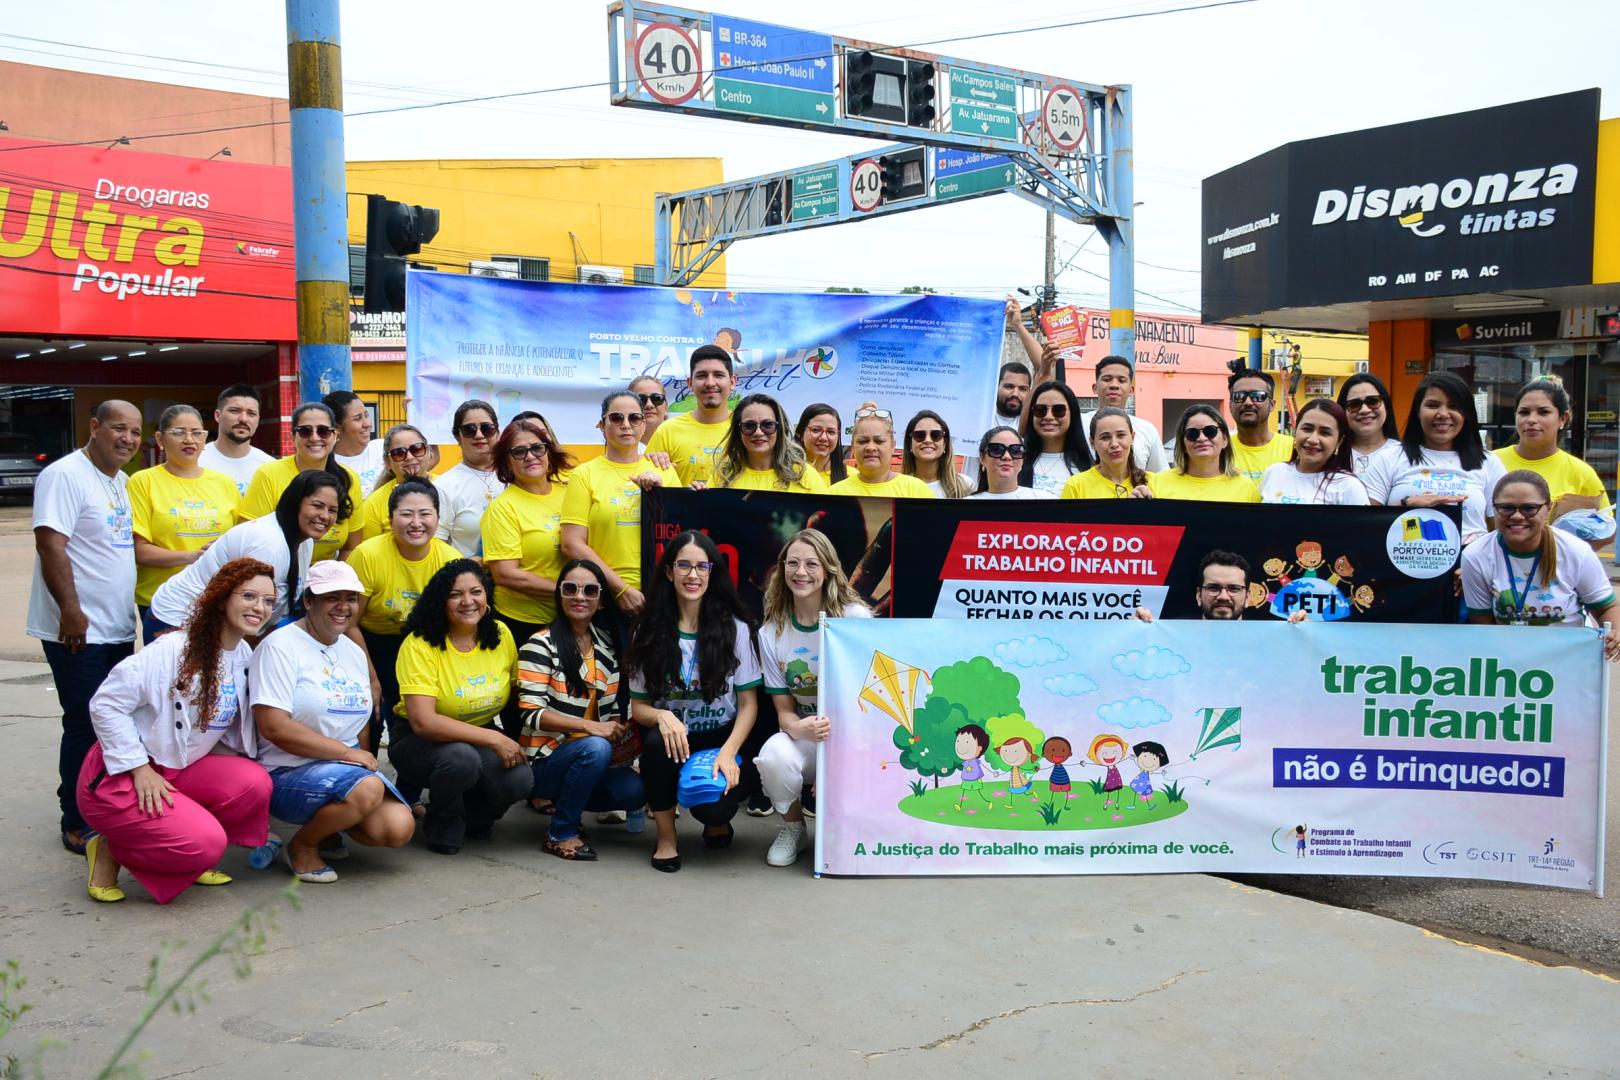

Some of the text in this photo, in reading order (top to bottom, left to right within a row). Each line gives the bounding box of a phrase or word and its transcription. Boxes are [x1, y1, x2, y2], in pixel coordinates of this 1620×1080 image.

[734, 31, 767, 49] BR-364
[643, 41, 692, 76] 40
[784, 64, 807, 80] Paulo
[808, 68, 815, 80] II
[656, 82, 685, 93] Km/h
[951, 72, 1015, 94] Av. Campos Sales
[721, 89, 752, 104] Centro
[959, 108, 1010, 126] Av. Jatuarana
[1051, 109, 1080, 127] 5,5m
[948, 153, 981, 168] Hosp. João
[806, 172, 833, 184] Jatuarana
[855, 171, 879, 194] 40
[94, 178, 210, 209] Drogarias
[938, 183, 959, 194] Centro
[1311, 162, 1579, 226] Dismonza
[801, 198, 821, 209] Campos
[822, 195, 836, 205] Sales
[0, 186, 206, 267] Ultra
[1459, 206, 1557, 236] tintas
[72, 263, 206, 300] Popular
[1368, 265, 1500, 288] RO AM DF PA AC
[590, 332, 621, 341] PORTO
[624, 334, 654, 342] VELHO
[656, 335, 695, 344] CONTRA
[1475, 321, 1532, 340] Suvinil
[488, 344, 493, 355] A
[578, 348, 583, 360] O
[1153, 344, 1181, 365] Bom
[459, 361, 483, 373] FUTURO
[486, 362, 493, 374] DE
[495, 363, 525, 377] CRIANÇAS
[526, 364, 530, 376] E
[656, 523, 681, 540] DIGA
[977, 531, 1143, 555] EXPLORAÇÃO DO
[1393, 547, 1456, 556] PORTO VELHO
[962, 554, 1157, 576] TRABALHO INFANTIL
[955, 588, 1142, 608] QUANTO MAIS VOCÊ
[1283, 592, 1337, 616] PETI
[1320, 655, 1555, 699] trabalho
[1363, 697, 1554, 744] infantil
[1283, 754, 1551, 790] não é brinquedo!
[1311, 828, 1355, 837] Programa de
[854, 841, 1234, 859] A Justiça do Trabalho mais próxima de você.
[1310, 838, 1341, 846] Combate
[1353, 838, 1384, 847] Trabalho
[1385, 839, 1412, 848] Infantil
[1315, 848, 1346, 857] Estímulo
[1353, 848, 1403, 858] Aprendizagem
[1439, 850, 1517, 864] TST CSJT
[1552, 858, 1575, 868] REGIÃO
